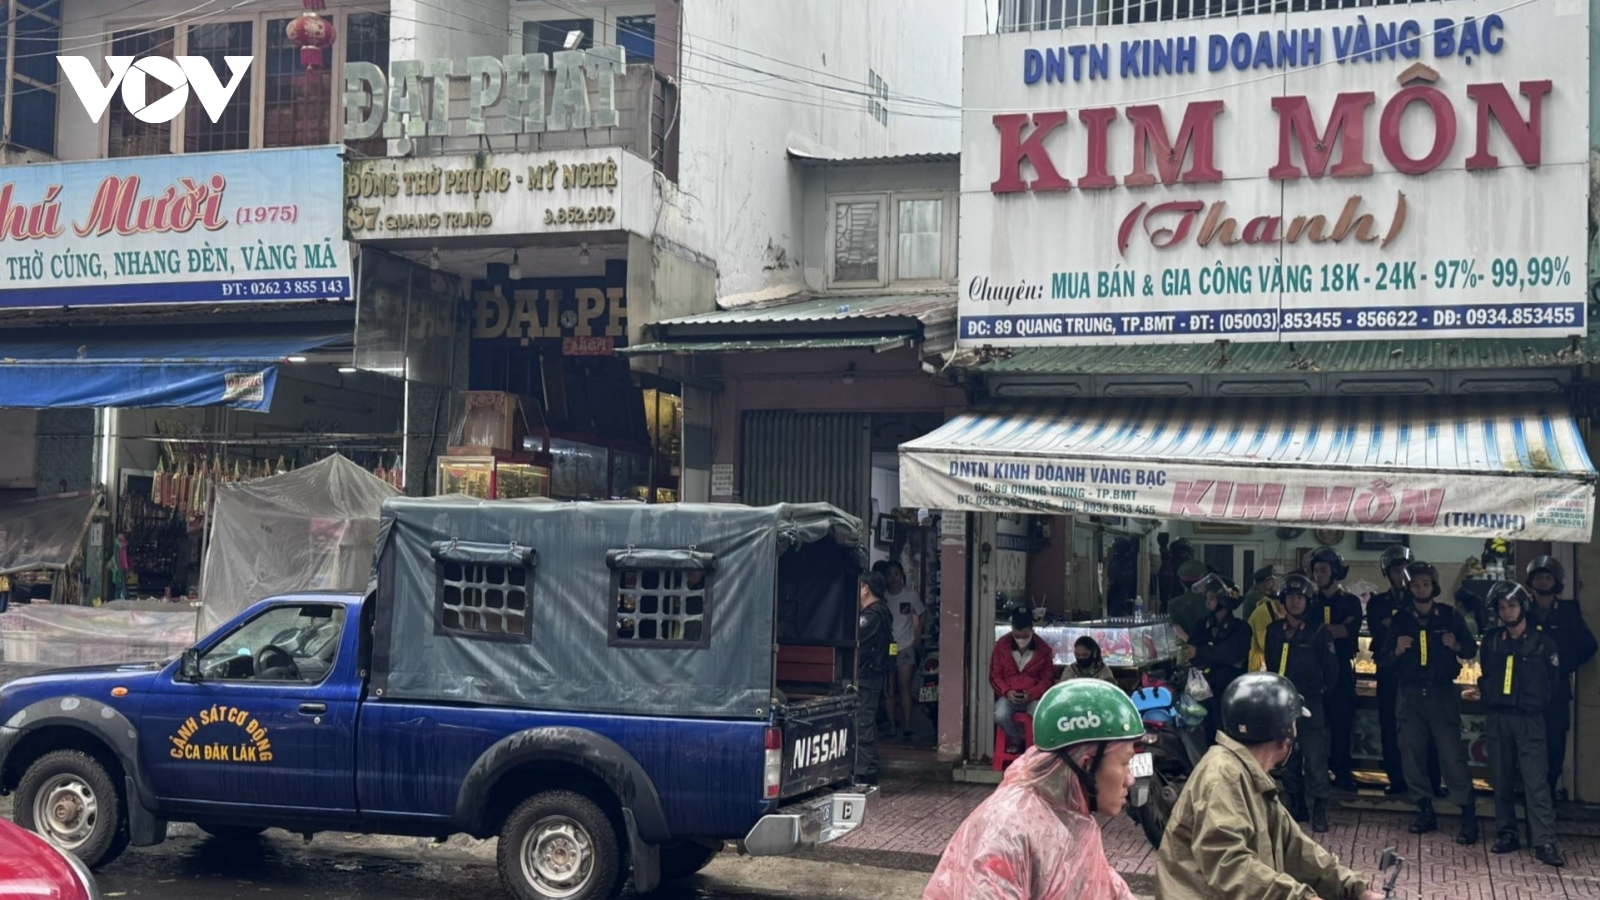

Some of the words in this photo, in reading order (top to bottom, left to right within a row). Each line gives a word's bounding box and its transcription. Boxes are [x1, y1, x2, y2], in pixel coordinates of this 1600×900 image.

[1023, 43, 1109, 84] DNTN
[1119, 36, 1197, 79] KINH
[1207, 28, 1322, 72] DOANH
[1331, 14, 1421, 64] VÀNG
[1433, 14, 1506, 66] BẠC
[342, 58, 453, 156] ĐẠI
[990, 100, 1225, 194] KIM
[1268, 62, 1554, 181] MÔN
[403, 163, 442, 197] THỜ
[444, 167, 511, 200] PHỤNG
[527, 159, 558, 192] MỸ
[562, 156, 618, 194] NGHỆ
[72, 172, 228, 238] Mười
[235, 204, 299, 226] (1975)
[385, 212, 441, 232] QUANG
[443, 211, 493, 230] TRUNG
[1117, 189, 1407, 257] (Thanh)
[6, 248, 45, 281] THỜ
[51, 247, 108, 281] CÚNG,
[114, 249, 181, 277] NHANG
[188, 241, 235, 275] ĐÈN,
[241, 238, 298, 271] VÀNG
[303, 237, 338, 269] MÃ
[222, 282, 248, 296] ĐT:
[251, 281, 281, 295] 0262
[284, 281, 292, 293] 3
[295, 281, 317, 293] 855
[322, 280, 343, 292] 143
[968, 275, 1044, 307] Chuyên:
[1052, 271, 1091, 299] MUA
[1097, 263, 1135, 299] BÁN
[1142, 277, 1154, 296] &
[1161, 268, 1192, 296] GIA
[1199, 260, 1253, 295] CÔNG
[1258, 257, 1312, 293] VÀNG
[1320, 263, 1360, 293] 18K
[1375, 261, 1417, 291] 24K
[1491, 256, 1571, 293] 99,99%
[473, 288, 563, 346] ĐẠI
[968, 320, 991, 336] ĐC:
[994, 319, 1012, 335] 89
[1016, 317, 1062, 336] QUANG
[1066, 316, 1116, 335] TRUNG,
[1121, 315, 1176, 332] TP.BMT
[1190, 313, 1214, 331] ĐT:
[1356, 310, 1418, 328] 856622
[1433, 309, 1461, 326] DĐ:
[1466, 307, 1576, 326] 0934.853455
[950, 460, 989, 478] DNTN
[993, 462, 1031, 480] KINH
[1035, 465, 1086, 483] DOANH
[1091, 464, 1131, 485] VÀNG
[1136, 468, 1167, 490] BẠC
[1011, 484, 1047, 497] QUANG
[1050, 486, 1085, 498] TRUNG
[1096, 488, 1138, 500] TP.BMT
[1169, 479, 1286, 520] KIM
[1444, 511, 1526, 532] (THANH)
[200, 703, 227, 726] SÁT
[227, 707, 249, 727] CƠ
[1057, 710, 1101, 732] Grab
[184, 743, 201, 760] CA
[792, 727, 848, 770] NISSAN
